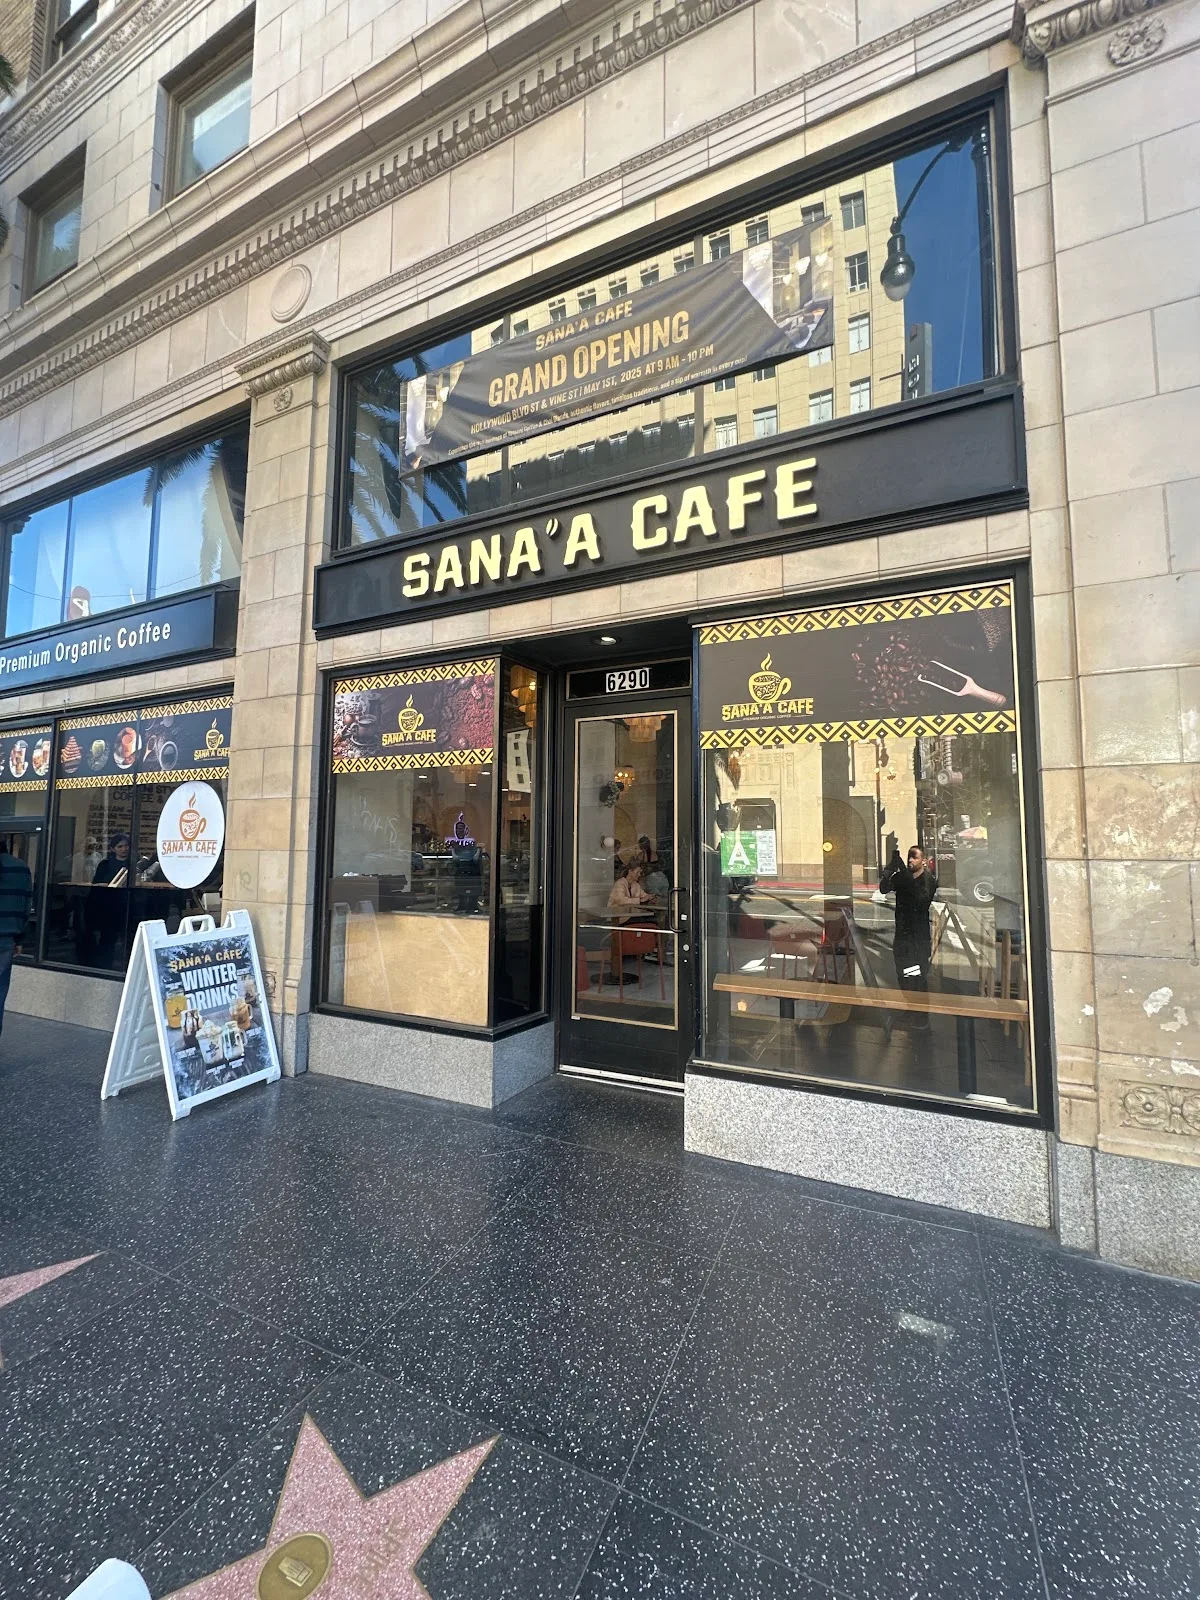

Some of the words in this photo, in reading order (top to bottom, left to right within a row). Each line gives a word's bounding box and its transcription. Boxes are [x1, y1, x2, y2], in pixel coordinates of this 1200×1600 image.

[536, 317, 589, 352] SANA'A
[594, 300, 633, 326] CAFE
[488, 354, 567, 407] GRAND
[573, 310, 689, 379] OPENING
[470, 412, 511, 434] HOLLYWOOD
[512, 404, 530, 421] BLVD
[530, 401, 540, 413] ST
[541, 399, 548, 409] &
[549, 393, 567, 406] VINE
[568, 389, 579, 400] ST
[584, 381, 601, 395] MAY
[602, 375, 618, 389] 1ST,
[620, 367, 642, 382] 2025
[645, 361, 656, 375] AT
[657, 359, 664, 371] 9
[665, 355, 680, 370] AM
[687, 350, 697, 363] 10
[699, 344, 714, 359] PM
[402, 512, 600, 598] SANA'A
[631, 457, 818, 551] CAFE
[0, 650, 50, 675] Premium
[55, 635, 112, 663] Organic
[117, 622, 171, 649] Coffee
[607, 669, 648, 691] 6290
[722, 703, 773, 721] SANA'A
[777, 698, 814, 715] CAFE
[382, 732, 412, 746] SANA'A
[415, 729, 436, 742] CAFE
[162, 841, 192, 855] SANA'A
[196, 841, 217, 855] CAFE
[728, 840, 751, 866] A
[170, 954, 212, 973] SANA'A
[216, 948, 242, 961] CAFE
[180, 963, 238, 992] WINTER
[185, 983, 239, 1012] DRINKS
